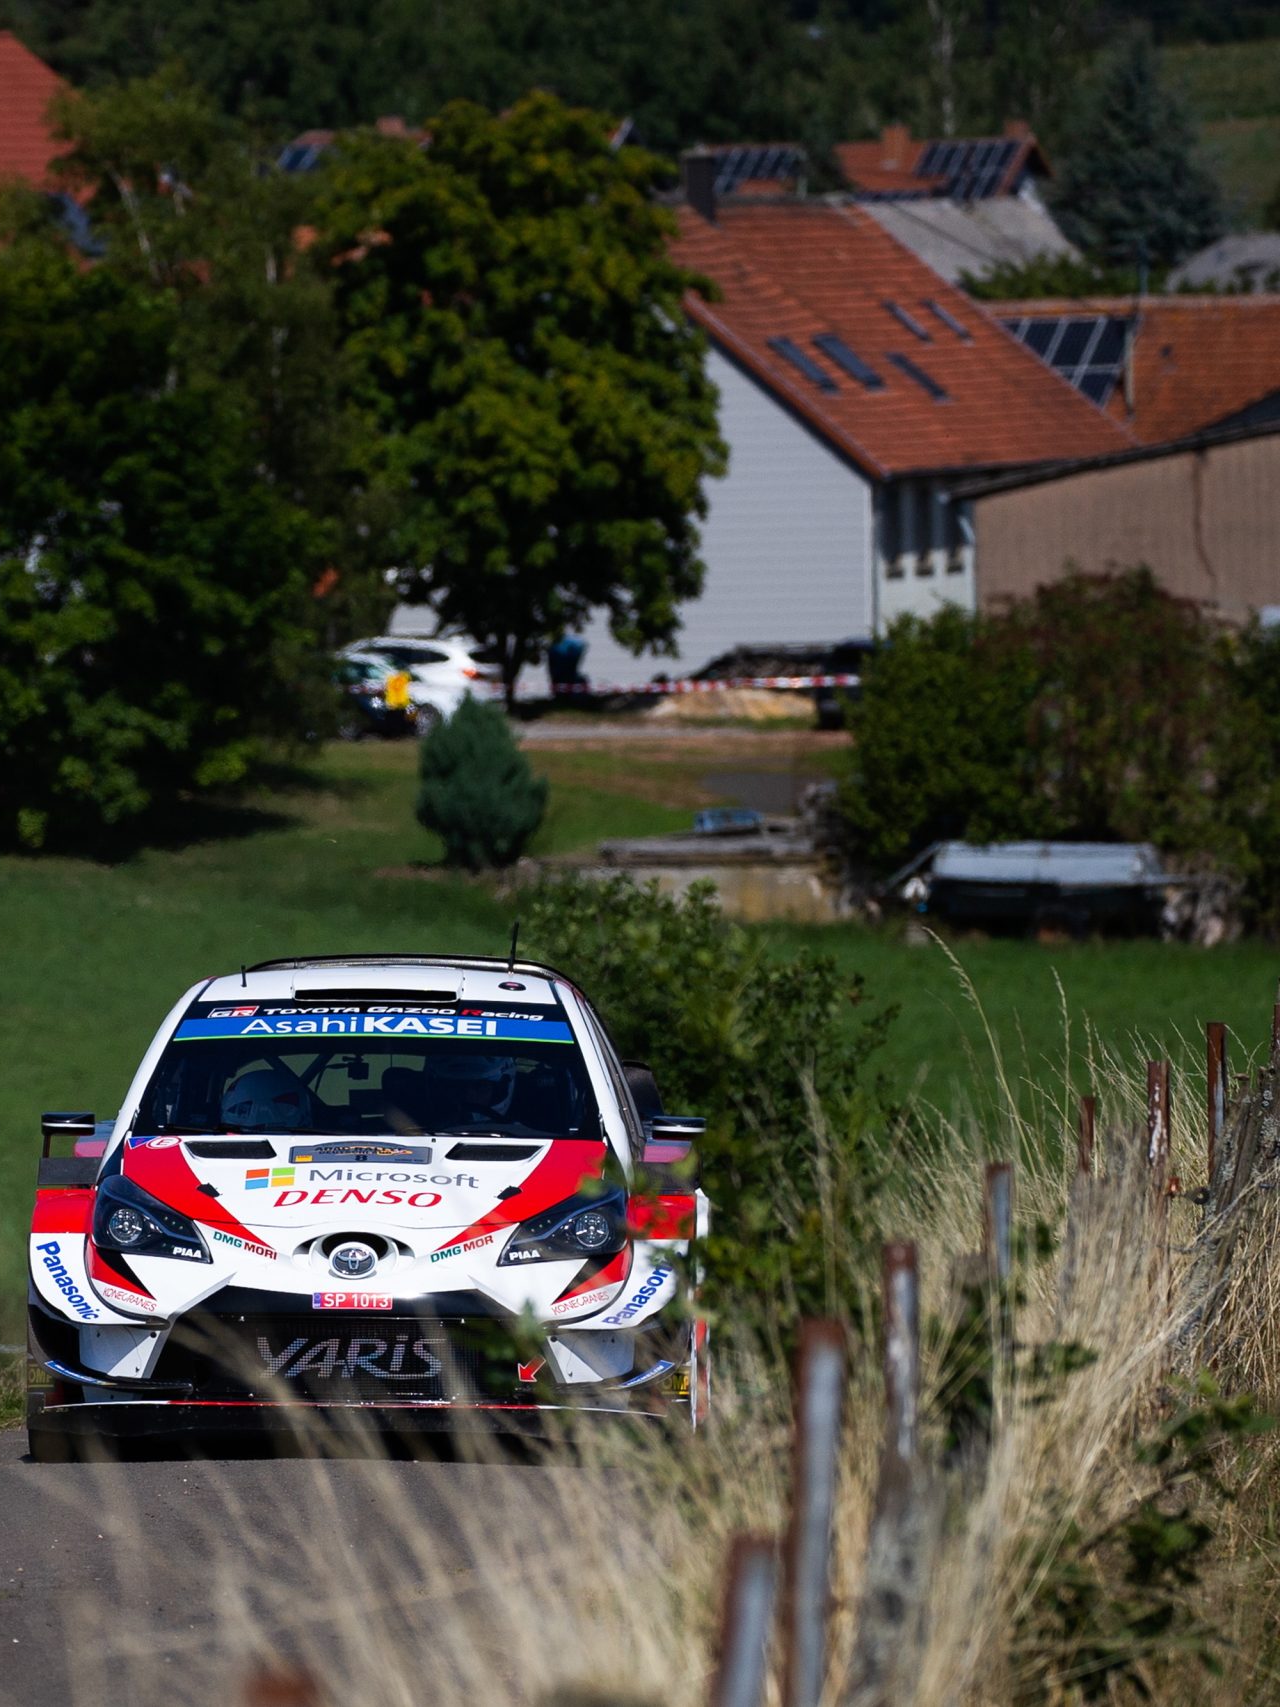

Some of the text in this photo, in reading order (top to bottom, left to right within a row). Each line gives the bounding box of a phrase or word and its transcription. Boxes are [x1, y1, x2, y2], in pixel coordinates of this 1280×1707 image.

[263, 1006, 361, 1015] TOYOTA
[366, 1006, 456, 1015] GAZOO
[461, 1008, 545, 1022] Racing
[309, 1168, 480, 1189] Microsoft
[273, 1188, 443, 1208] DENSO
[172, 1246, 203, 1259] PIAA
[213, 1231, 278, 1261] DMG MORI
[430, 1245, 462, 1263] DMG
[508, 1249, 541, 1261] PIAA
[36, 1240, 100, 1320] Panasonic
[102, 1286, 158, 1313] KONECRANES
[323, 1293, 390, 1308] SP 1013
[551, 1290, 610, 1316] KONECRANES
